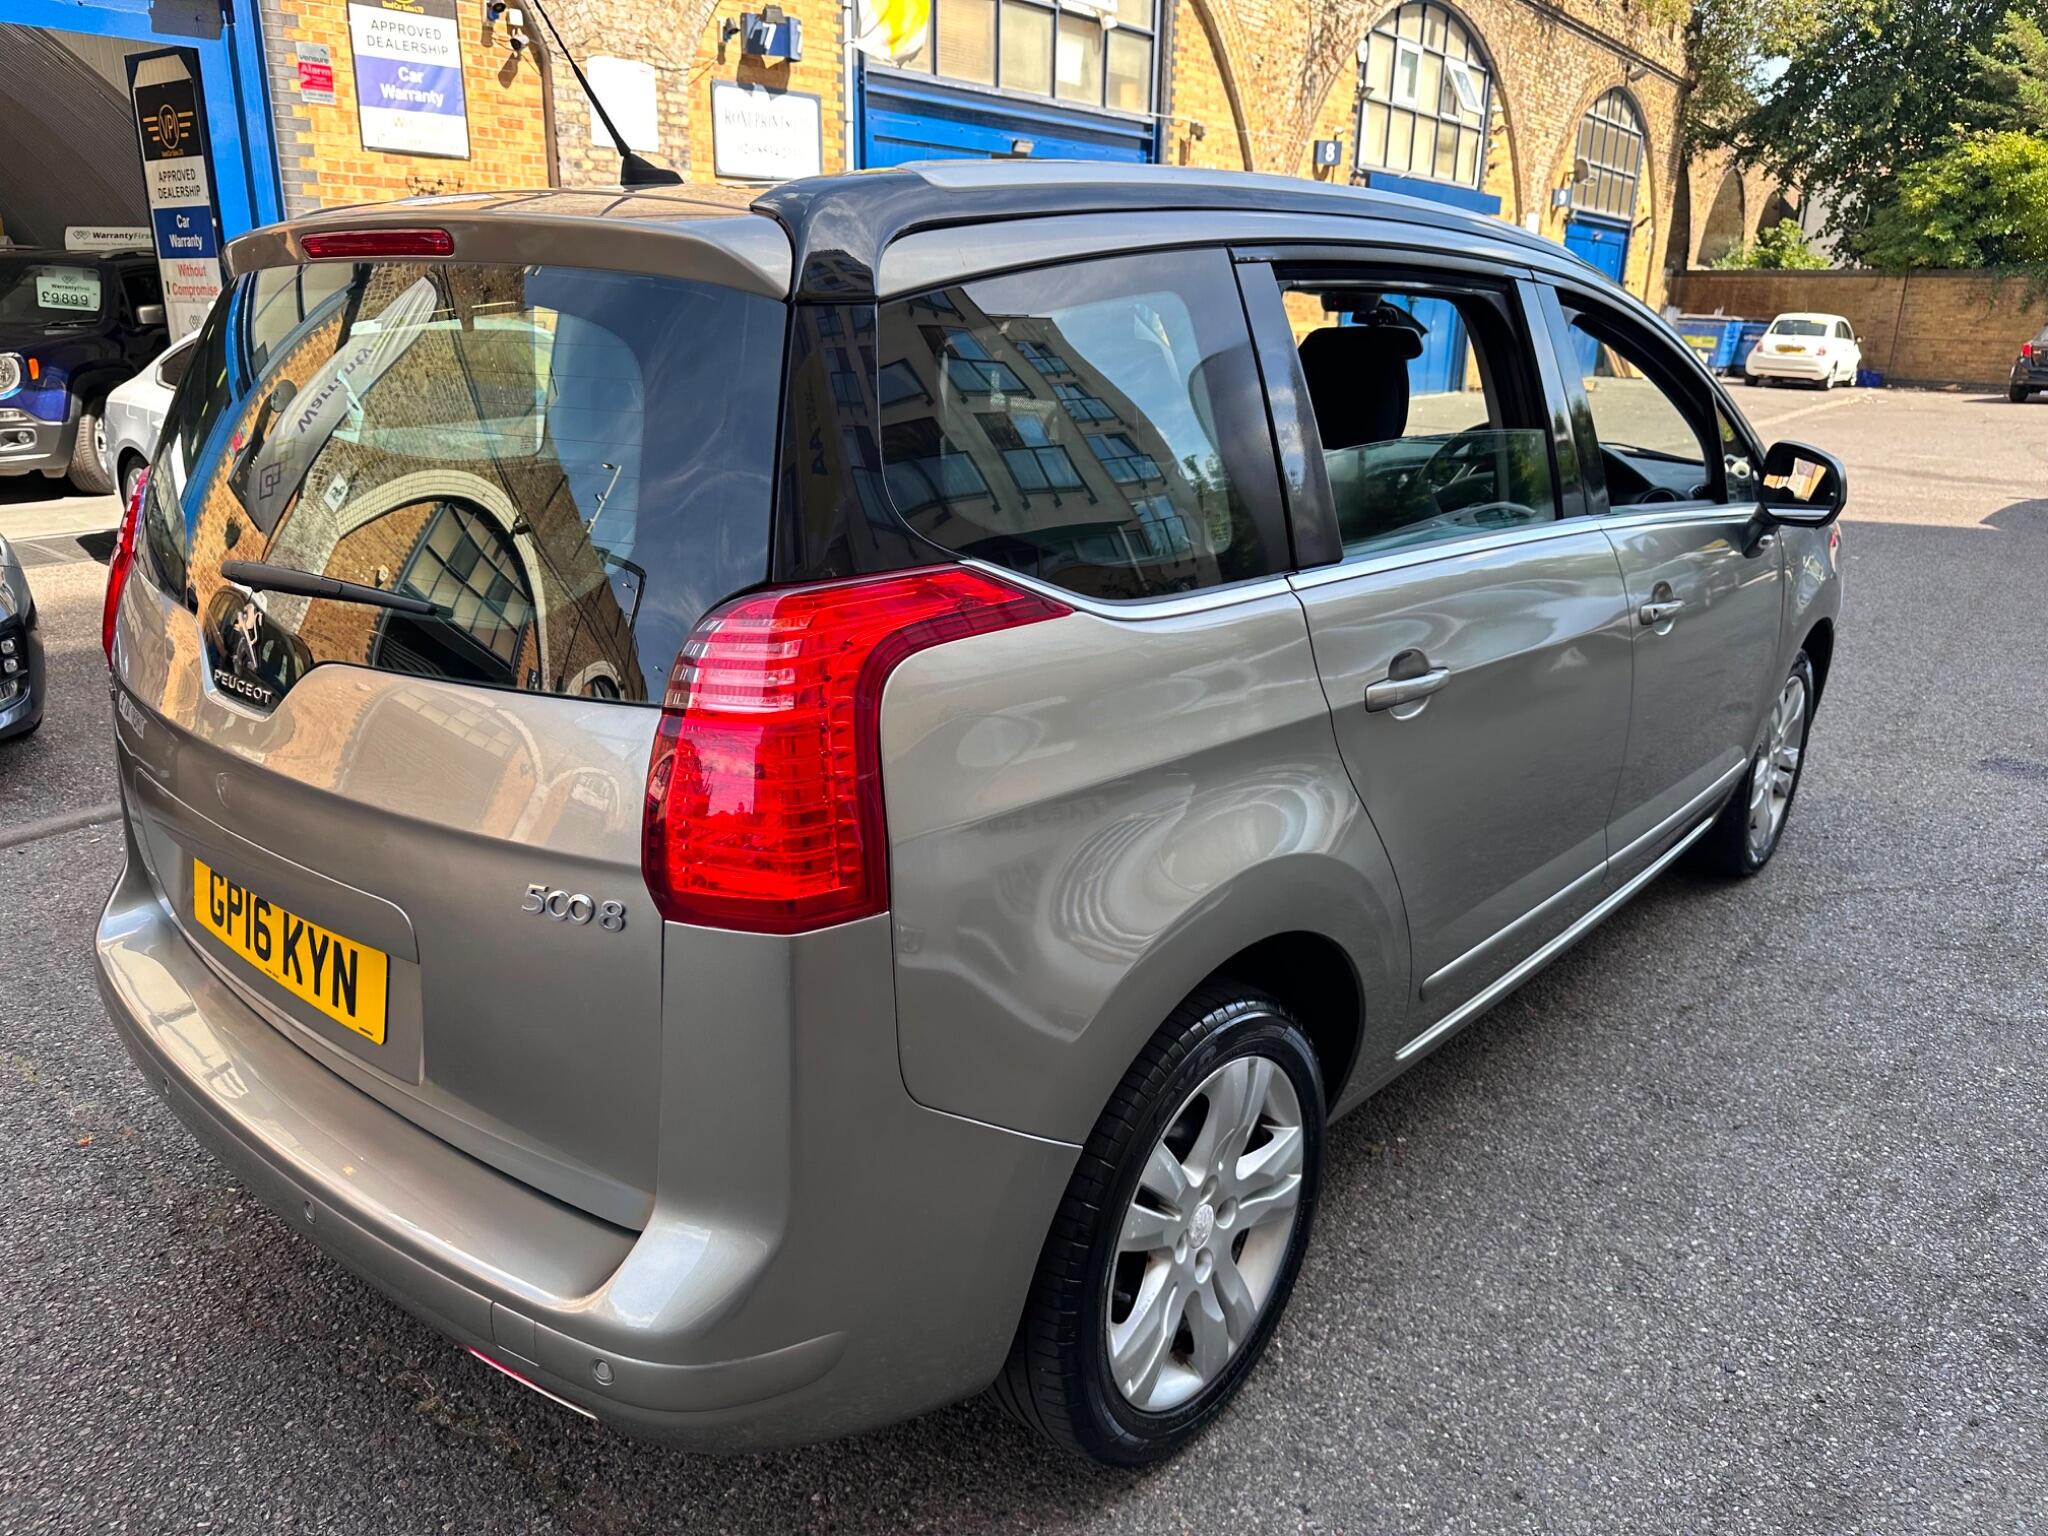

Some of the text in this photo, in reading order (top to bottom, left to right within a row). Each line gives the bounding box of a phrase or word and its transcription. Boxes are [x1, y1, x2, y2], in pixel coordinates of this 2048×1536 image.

[371, 20, 441, 40] APPROVED
[762, 23, 777, 50] 7
[367, 35, 448, 55] DEALERSHIP
[300, 63, 331, 77] Alarm
[398, 66, 424, 83] Car
[381, 83, 444, 108] Warranty
[1325, 142, 1336, 162] 8
[158, 168, 196, 183] APPROVED
[158, 185, 201, 199] DEALERSHIP
[1559, 190, 1567, 205] 9
[176, 214, 190, 228] Car
[93, 232, 152, 241] WarrantyFirs
[169, 234, 203, 251] Warranty
[177, 264, 206, 277] Without
[42, 291, 88, 306] £9899
[172, 283, 218, 299] Compromise
[213, 669, 272, 703] PEUGEOT
[521, 883, 626, 933] 5008
[210, 869, 359, 1018] GP16 KYN
